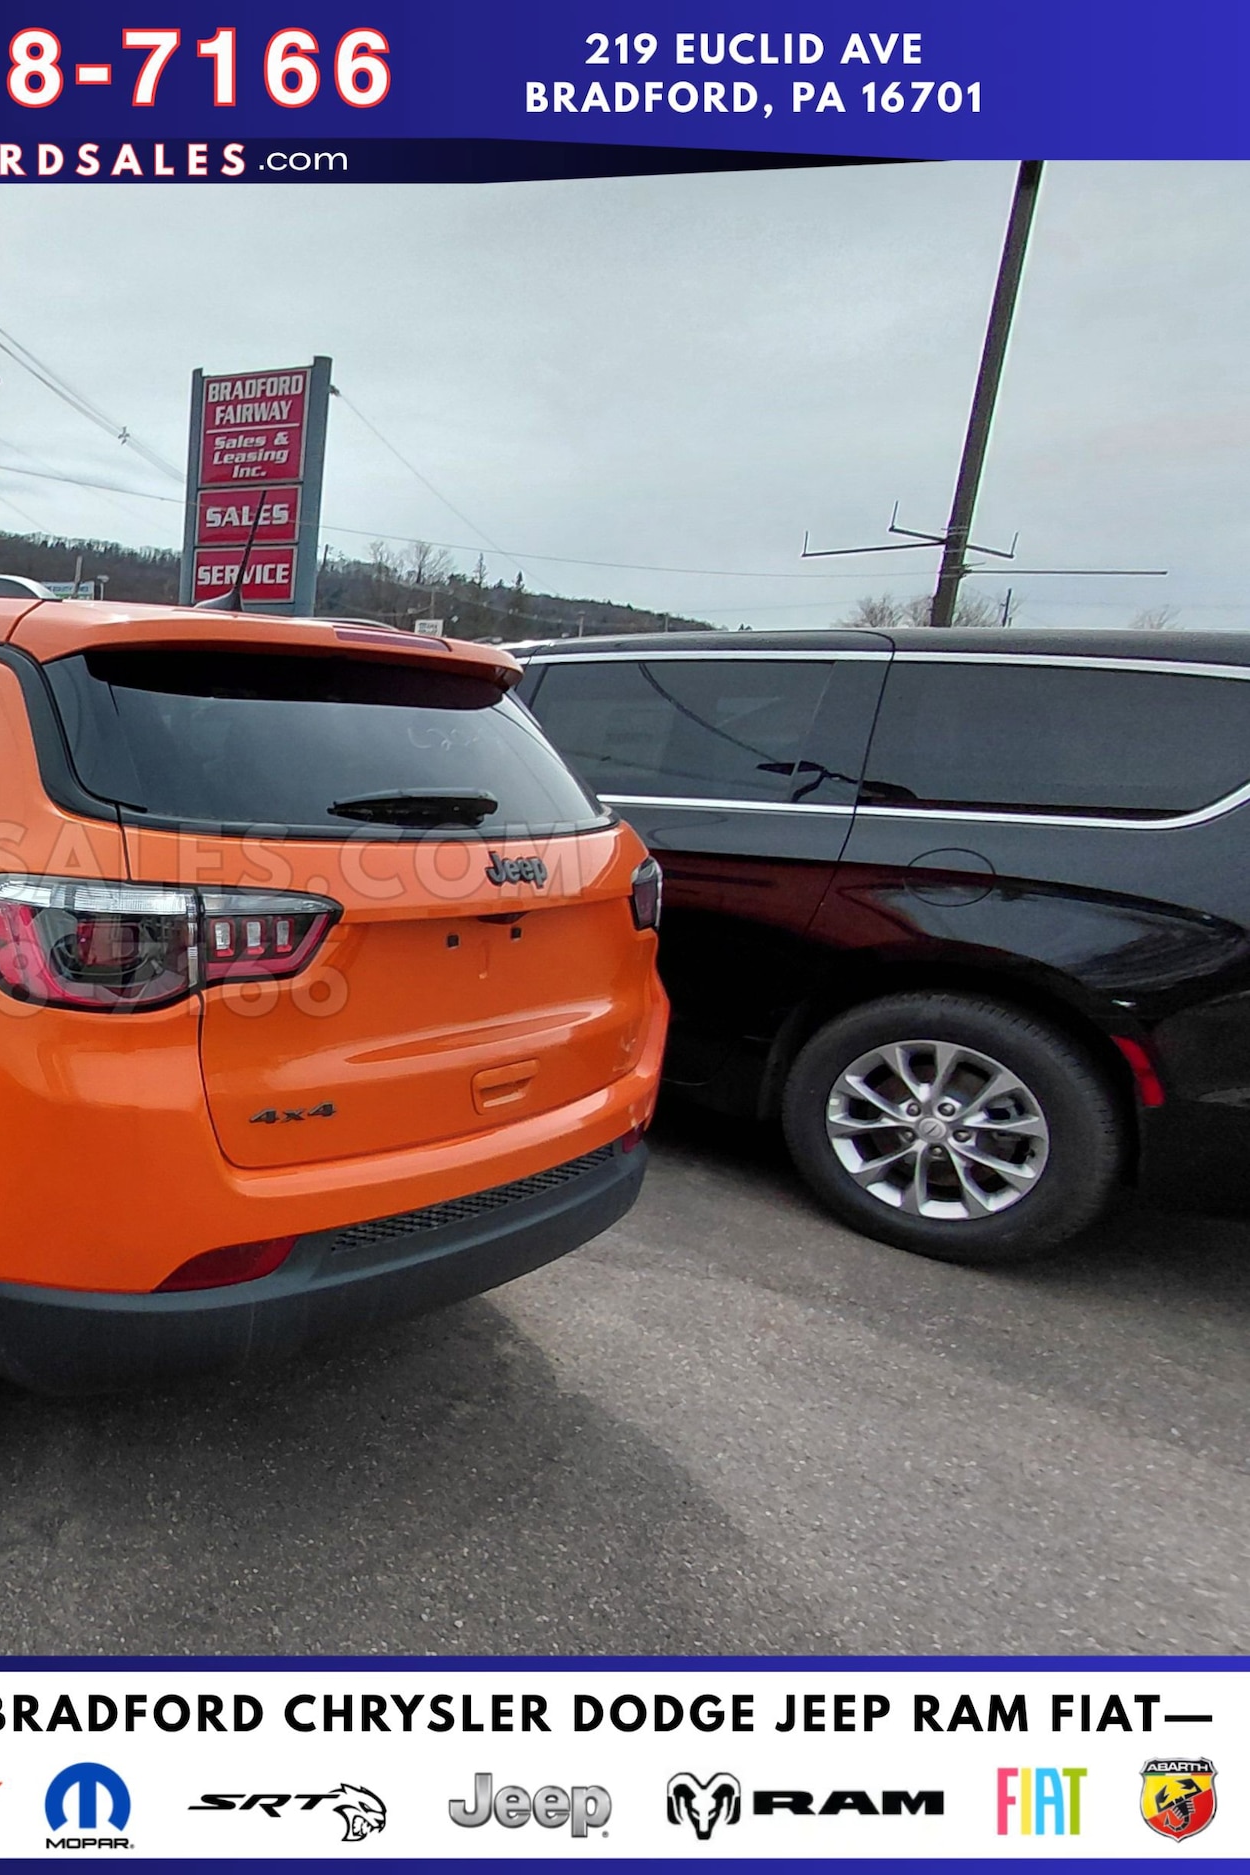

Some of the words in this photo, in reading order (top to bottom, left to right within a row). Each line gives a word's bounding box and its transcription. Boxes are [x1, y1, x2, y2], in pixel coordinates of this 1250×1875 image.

[208, 375, 303, 402] BRADFORD
[215, 401, 293, 425] FAIRWAY
[214, 434, 266, 450] Sales
[274, 431, 289, 445] &
[212, 448, 289, 465] Leasing
[232, 465, 266, 478] Inc.
[206, 504, 289, 528] SALES
[197, 563, 289, 585] SERVICE
[485, 850, 548, 888] Jeep
[249, 1101, 337, 1124] 4x4
